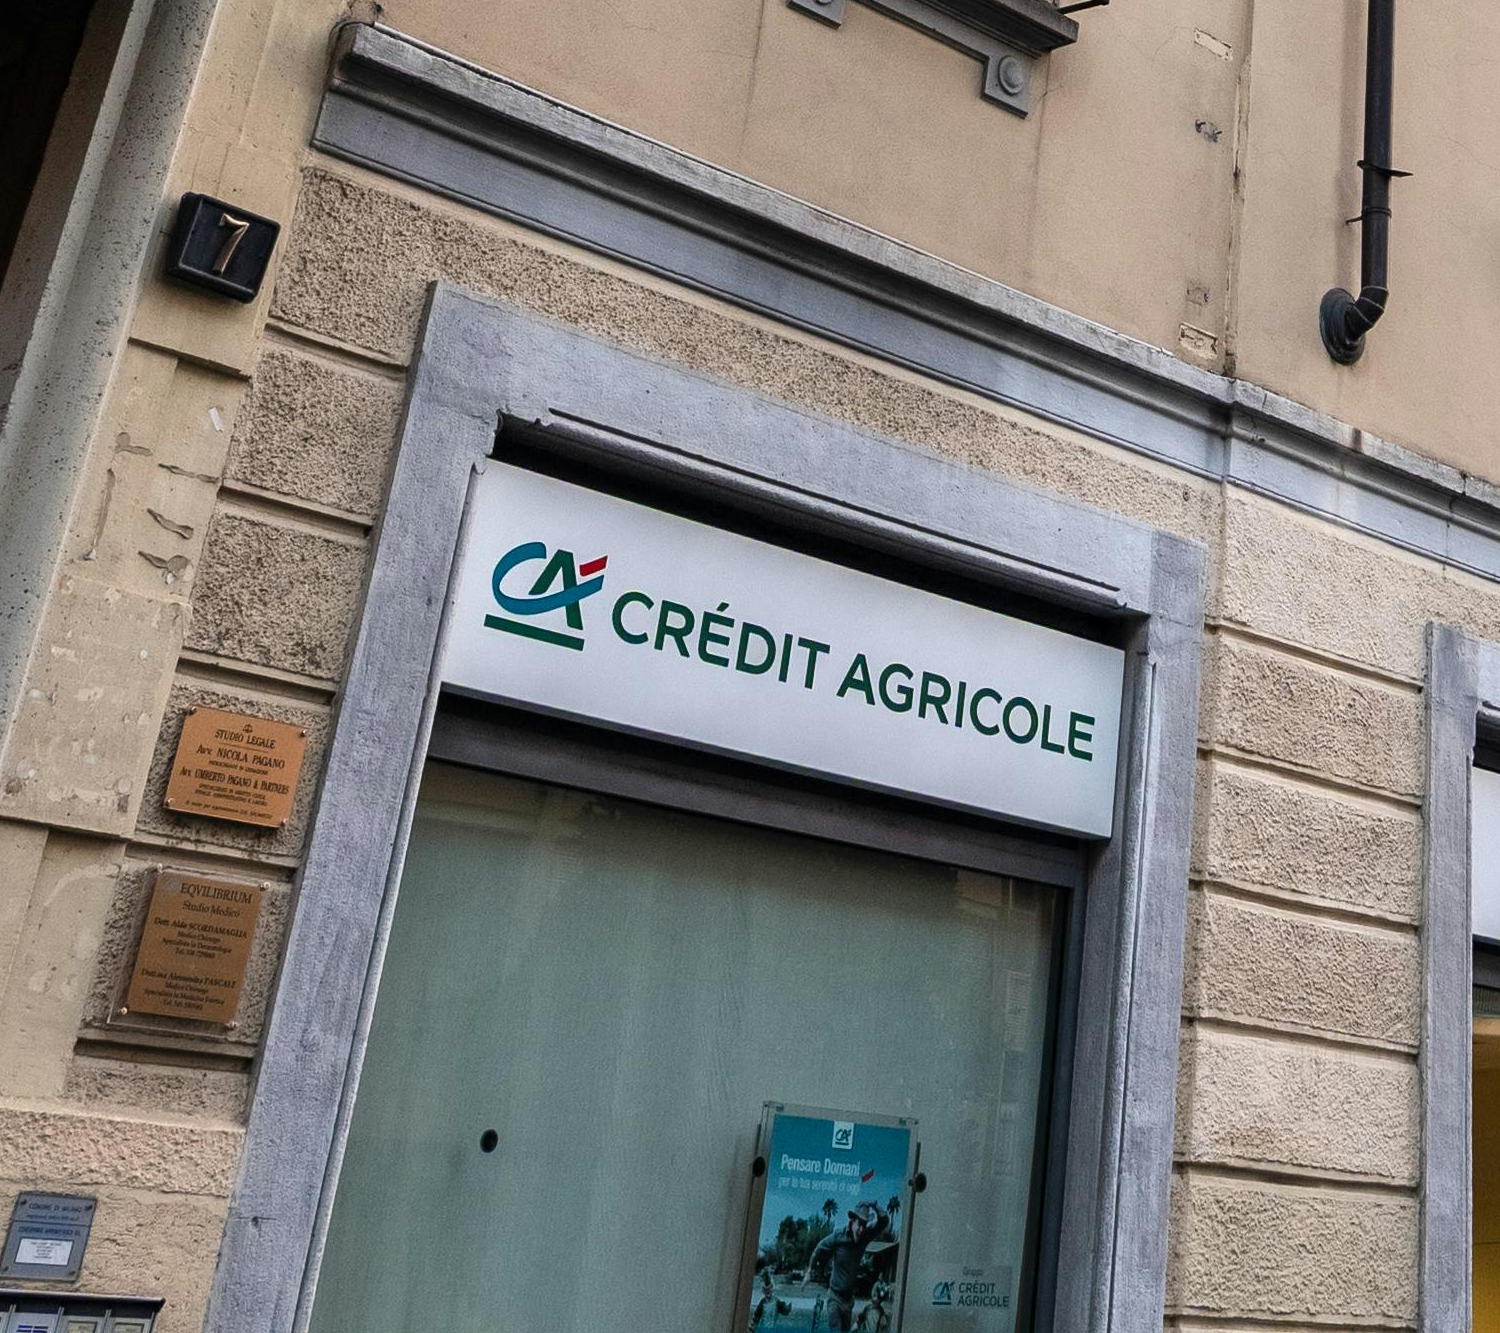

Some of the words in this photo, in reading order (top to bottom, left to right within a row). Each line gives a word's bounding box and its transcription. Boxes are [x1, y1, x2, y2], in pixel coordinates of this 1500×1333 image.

[218, 213, 249, 275] 7
[612, 591, 831, 691] CRÉDIT
[837, 652, 1096, 763] AGRICOLE
[215, 729, 244, 742] STUDIO
[246, 733, 276, 749] LEGALE
[216, 747, 248, 763] NICOLA
[252, 756, 286, 770] PAGANO
[227, 773, 252, 787] PAGANO
[180, 882, 253, 905] EQVILIBRIUM
[182, 900, 210, 914] Studio
[211, 904, 241, 918] Medico
[781, 1154, 820, 1172] Pensare
[823, 1158, 860, 1177] Domani
[958, 1279, 997, 1294] CRÉDIT
[957, 1295, 1010, 1308] AGRICOLE
